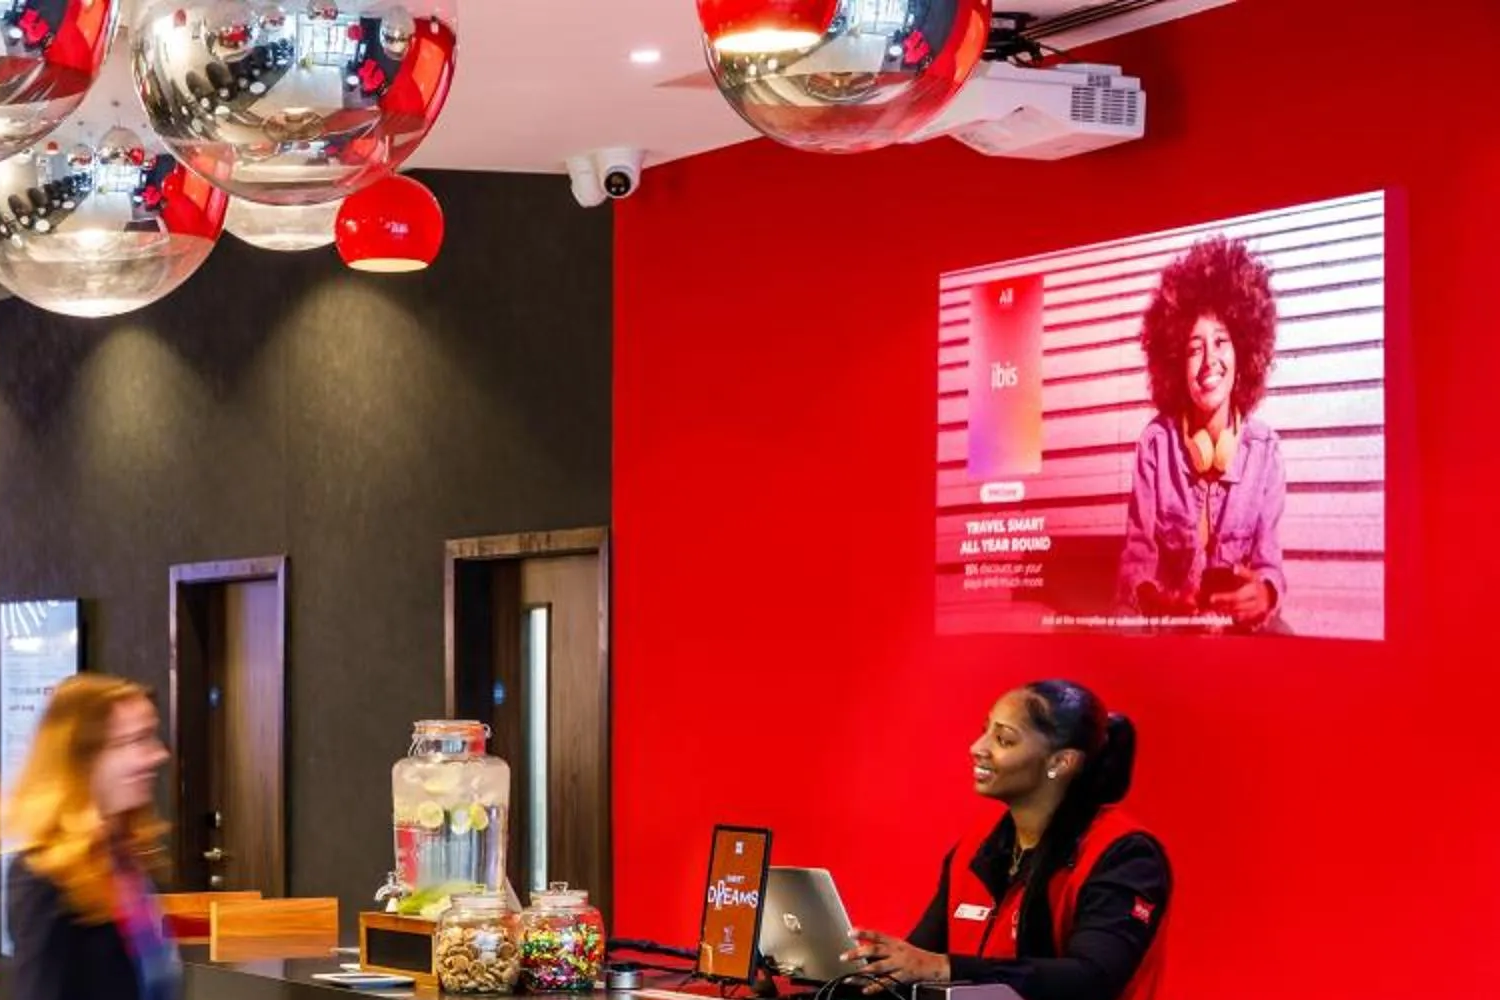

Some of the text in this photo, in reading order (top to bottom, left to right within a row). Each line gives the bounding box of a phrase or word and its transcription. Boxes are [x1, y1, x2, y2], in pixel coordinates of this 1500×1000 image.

[991, 362, 1018, 391] ibis
[966, 516, 1046, 535] TRAVEL SMART
[960, 536, 1051, 555] ALL YEAR ROUND
[707, 880, 759, 909] DREAMS
